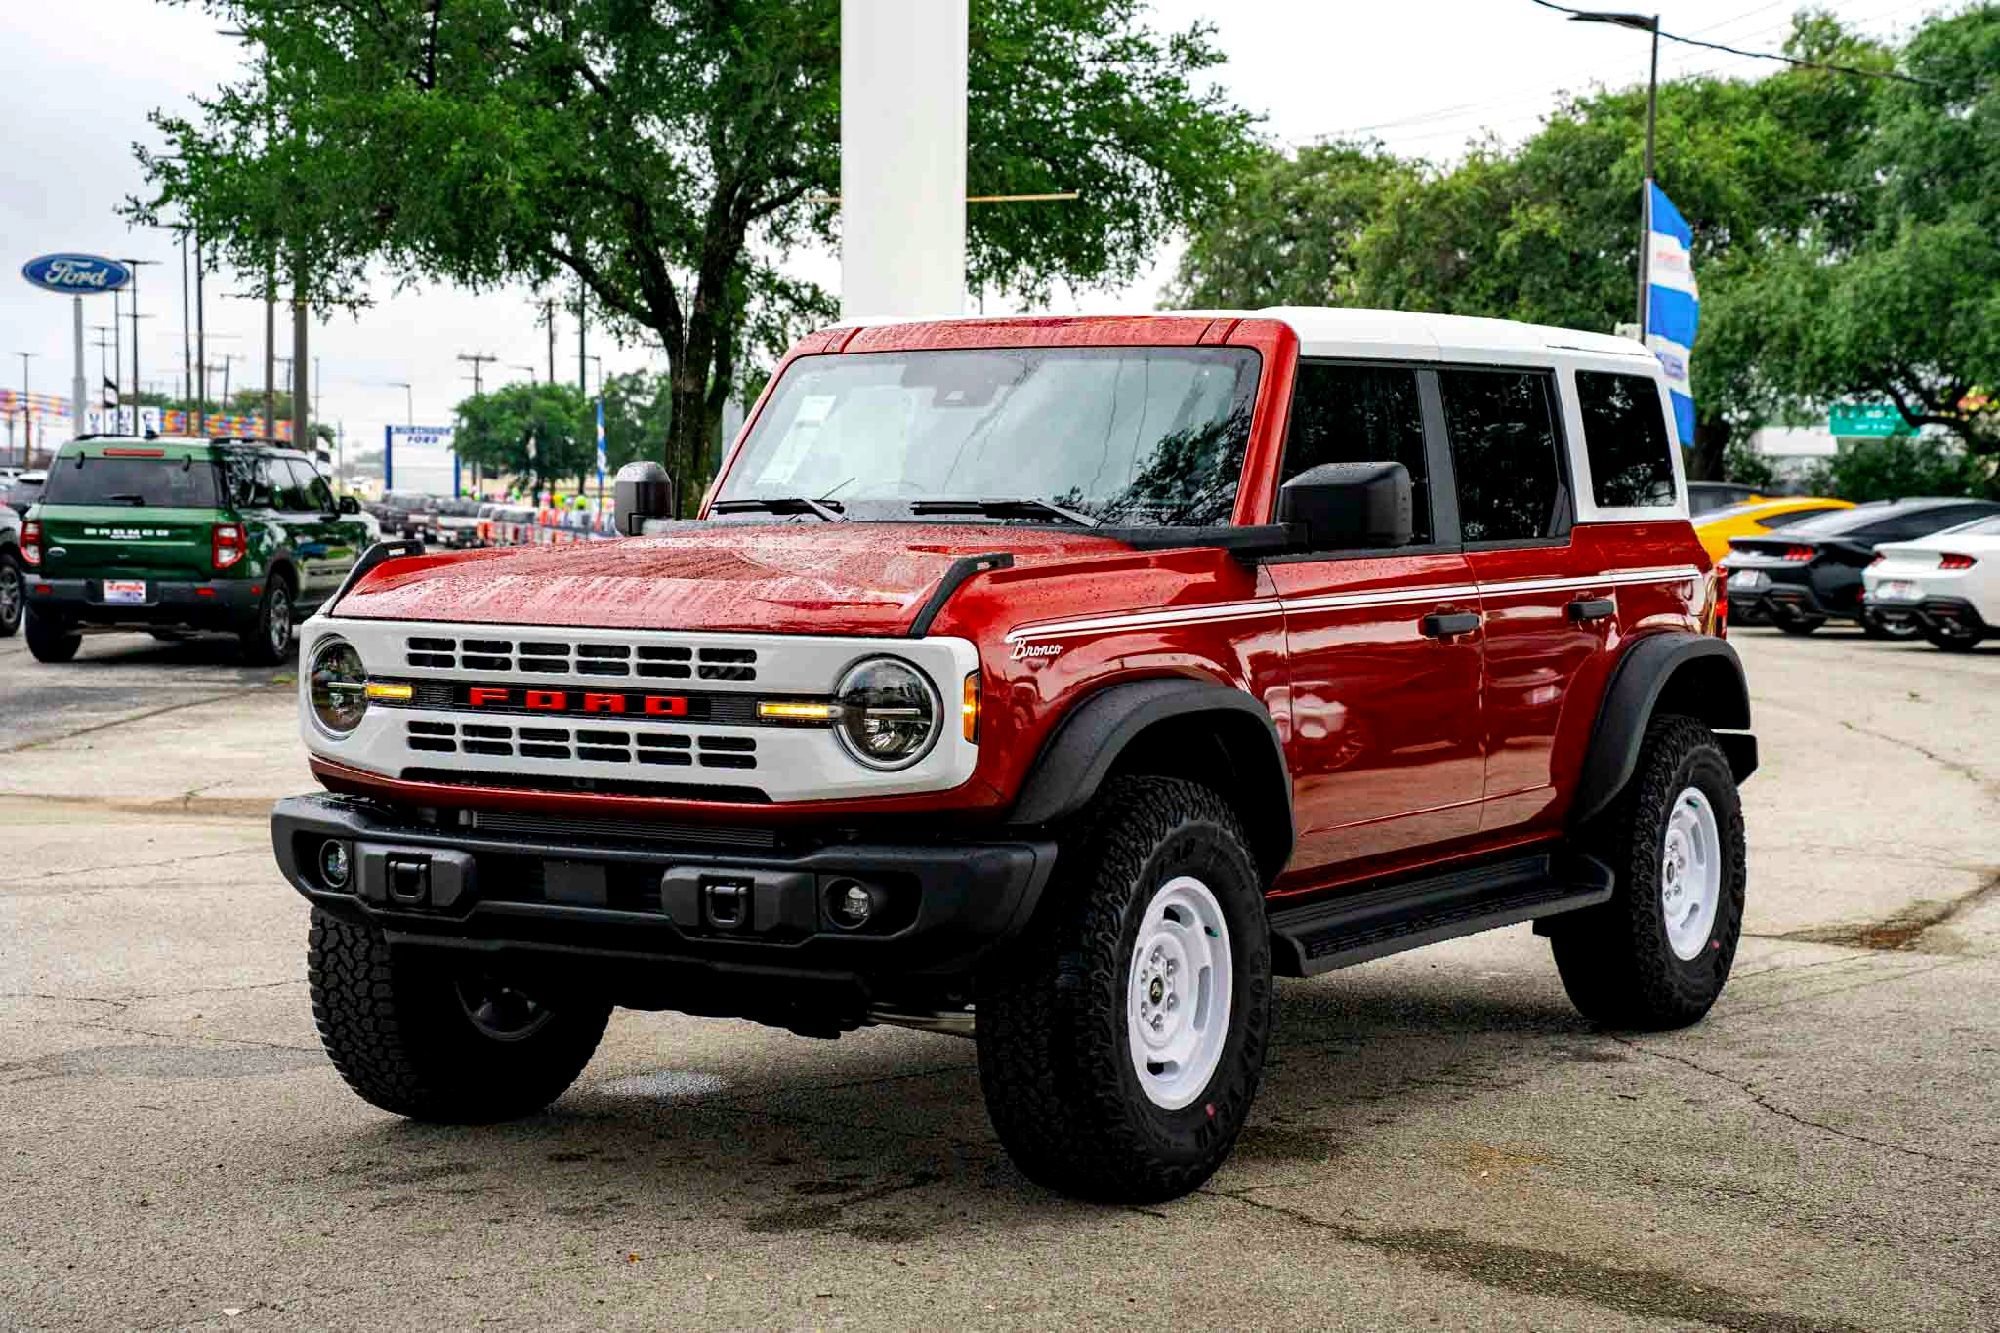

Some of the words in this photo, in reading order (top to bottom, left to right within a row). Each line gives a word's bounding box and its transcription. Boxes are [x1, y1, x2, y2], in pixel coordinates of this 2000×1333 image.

[45, 260, 109, 286] Ford
[407, 436, 438, 444] FORD
[1008, 637, 1064, 660] Bronco
[469, 687, 689, 717] FORD
